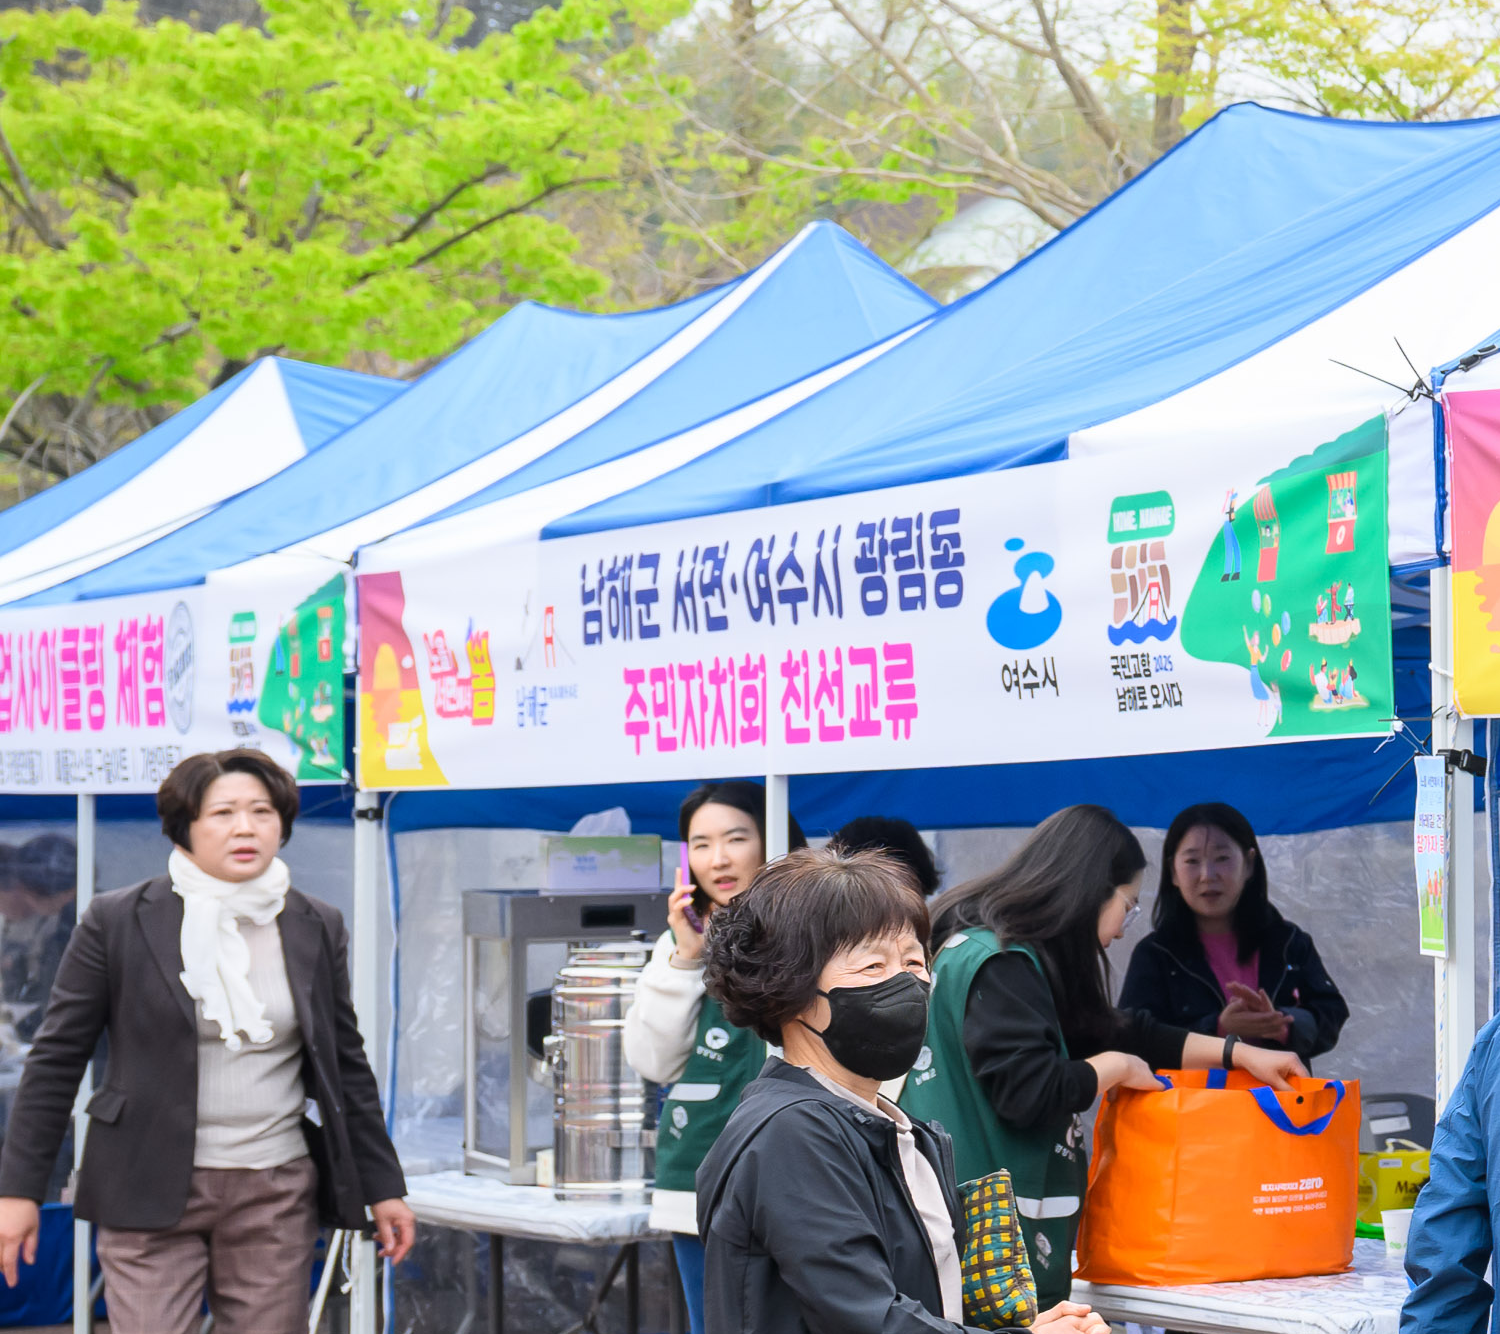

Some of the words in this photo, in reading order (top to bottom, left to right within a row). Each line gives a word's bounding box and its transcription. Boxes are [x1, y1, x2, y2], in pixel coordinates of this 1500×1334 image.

[581, 552, 662, 646] 남해군
[854, 507, 966, 617] 광림동
[114, 612, 166, 728] 체험
[623, 653, 769, 756] 주민자치회
[780, 642, 919, 747] 친선교류
[1001, 655, 1060, 700] 여수시
[1111, 653, 1151, 680] 국민고향
[1153, 655, 1173, 673] 2025
[1116, 686, 1148, 712] 남해로
[1150, 682, 1183, 710] 오시다
